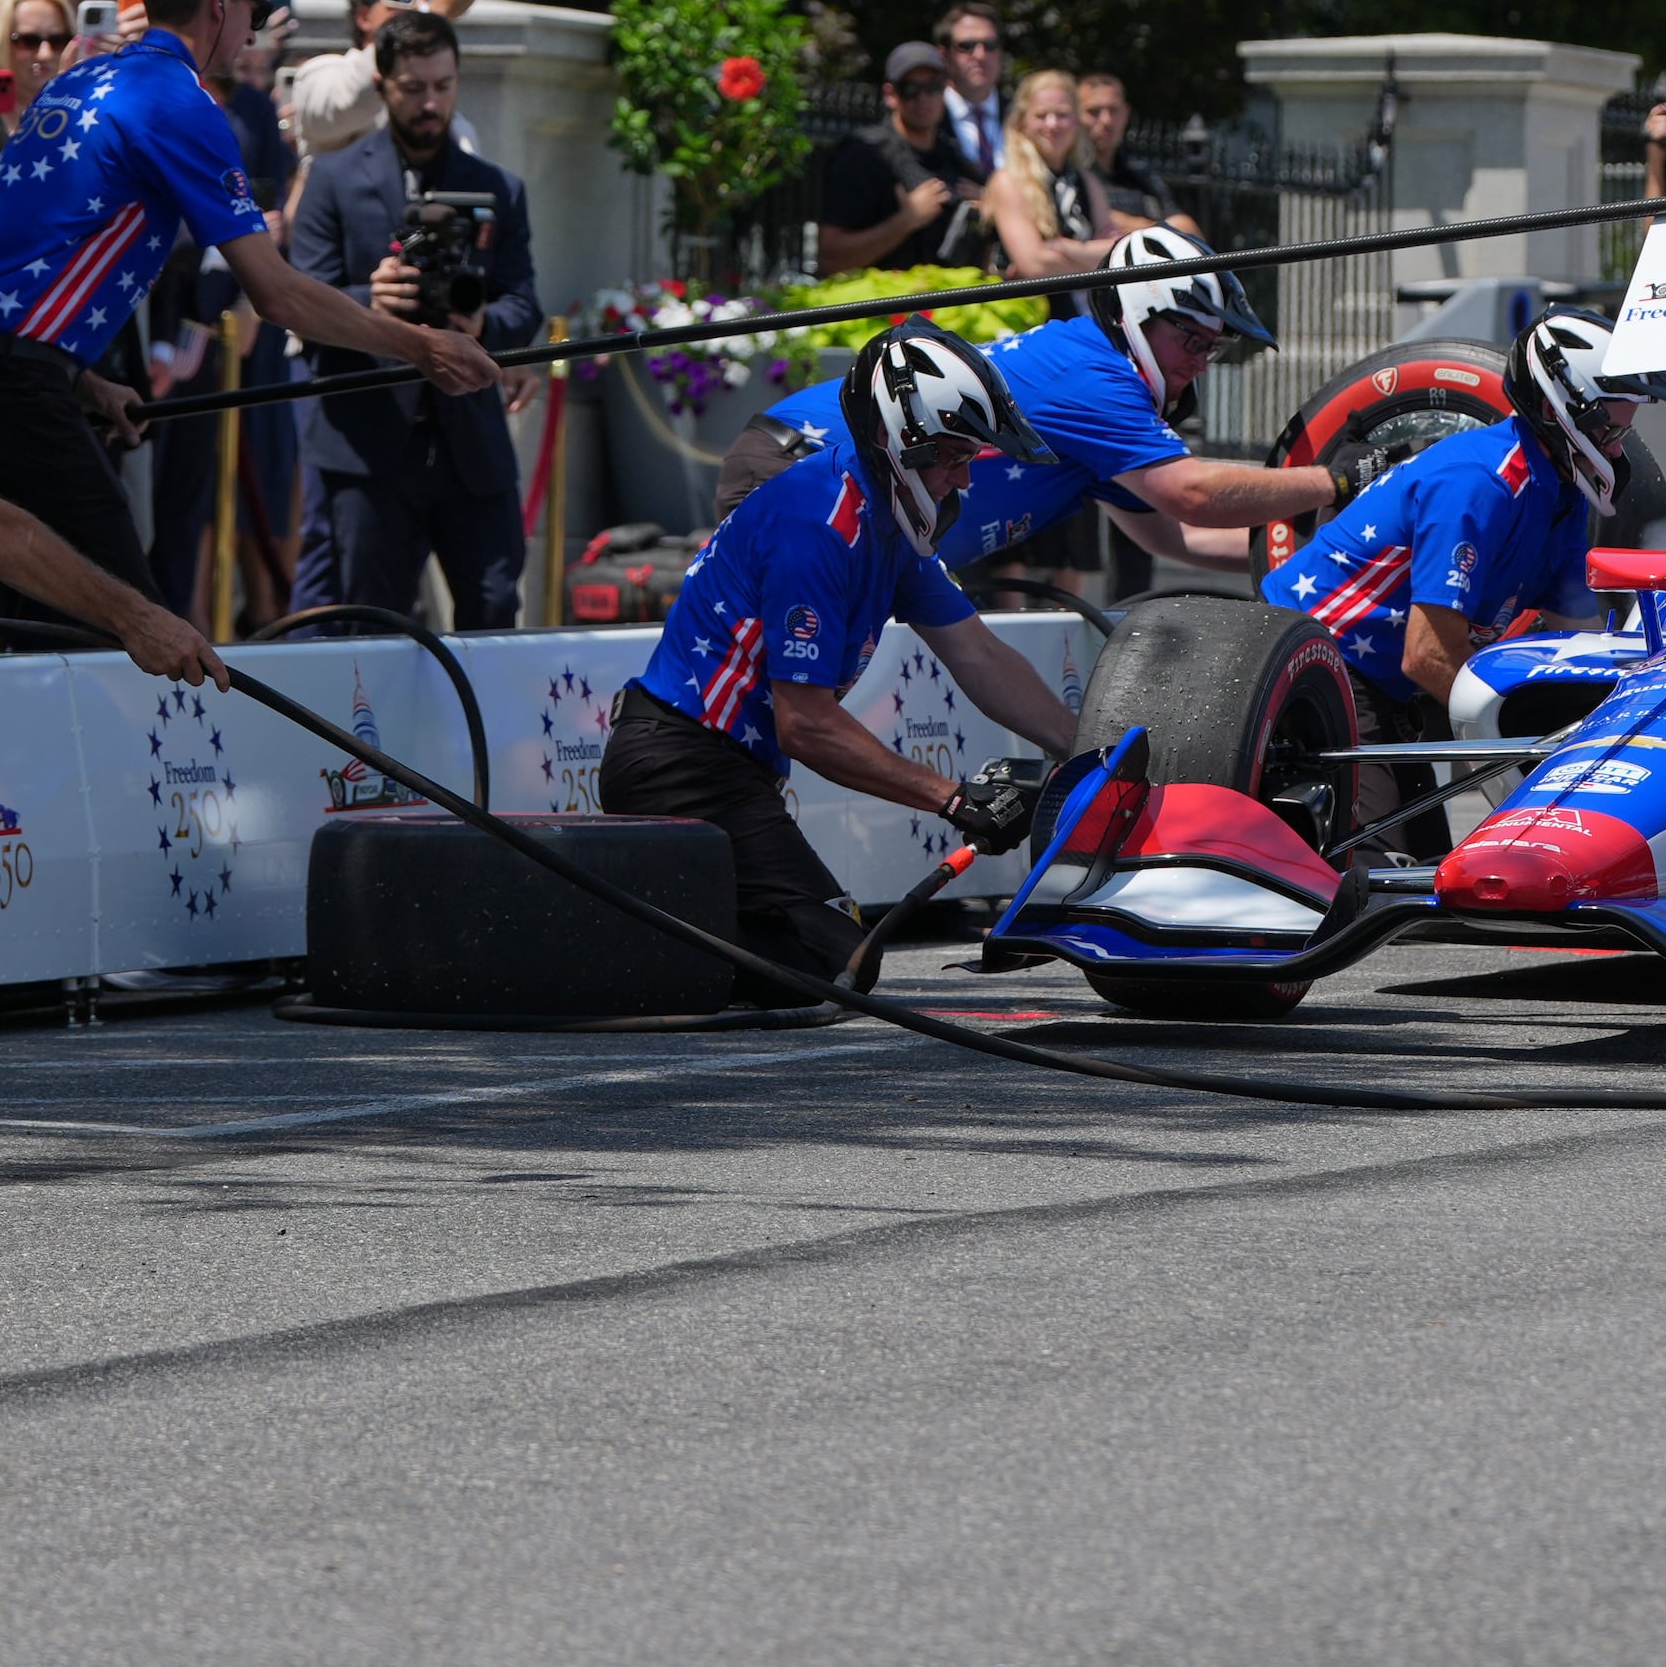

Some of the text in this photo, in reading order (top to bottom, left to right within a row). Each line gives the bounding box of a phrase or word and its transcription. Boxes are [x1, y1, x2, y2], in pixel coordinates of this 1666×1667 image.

[1446, 570, 1471, 593] 250
[783, 640, 819, 660] 250
[1288, 643, 1340, 683] Firestone
[906, 715, 950, 739] Freedom
[556, 738, 602, 762] Freedom
[163, 758, 217, 785] Freedom
[1539, 772, 1642, 787] INDCAR
[171, 788, 223, 859] 250
[1476, 819, 1594, 838] MONUMENTAL
[1463, 838, 1563, 854] dallara
